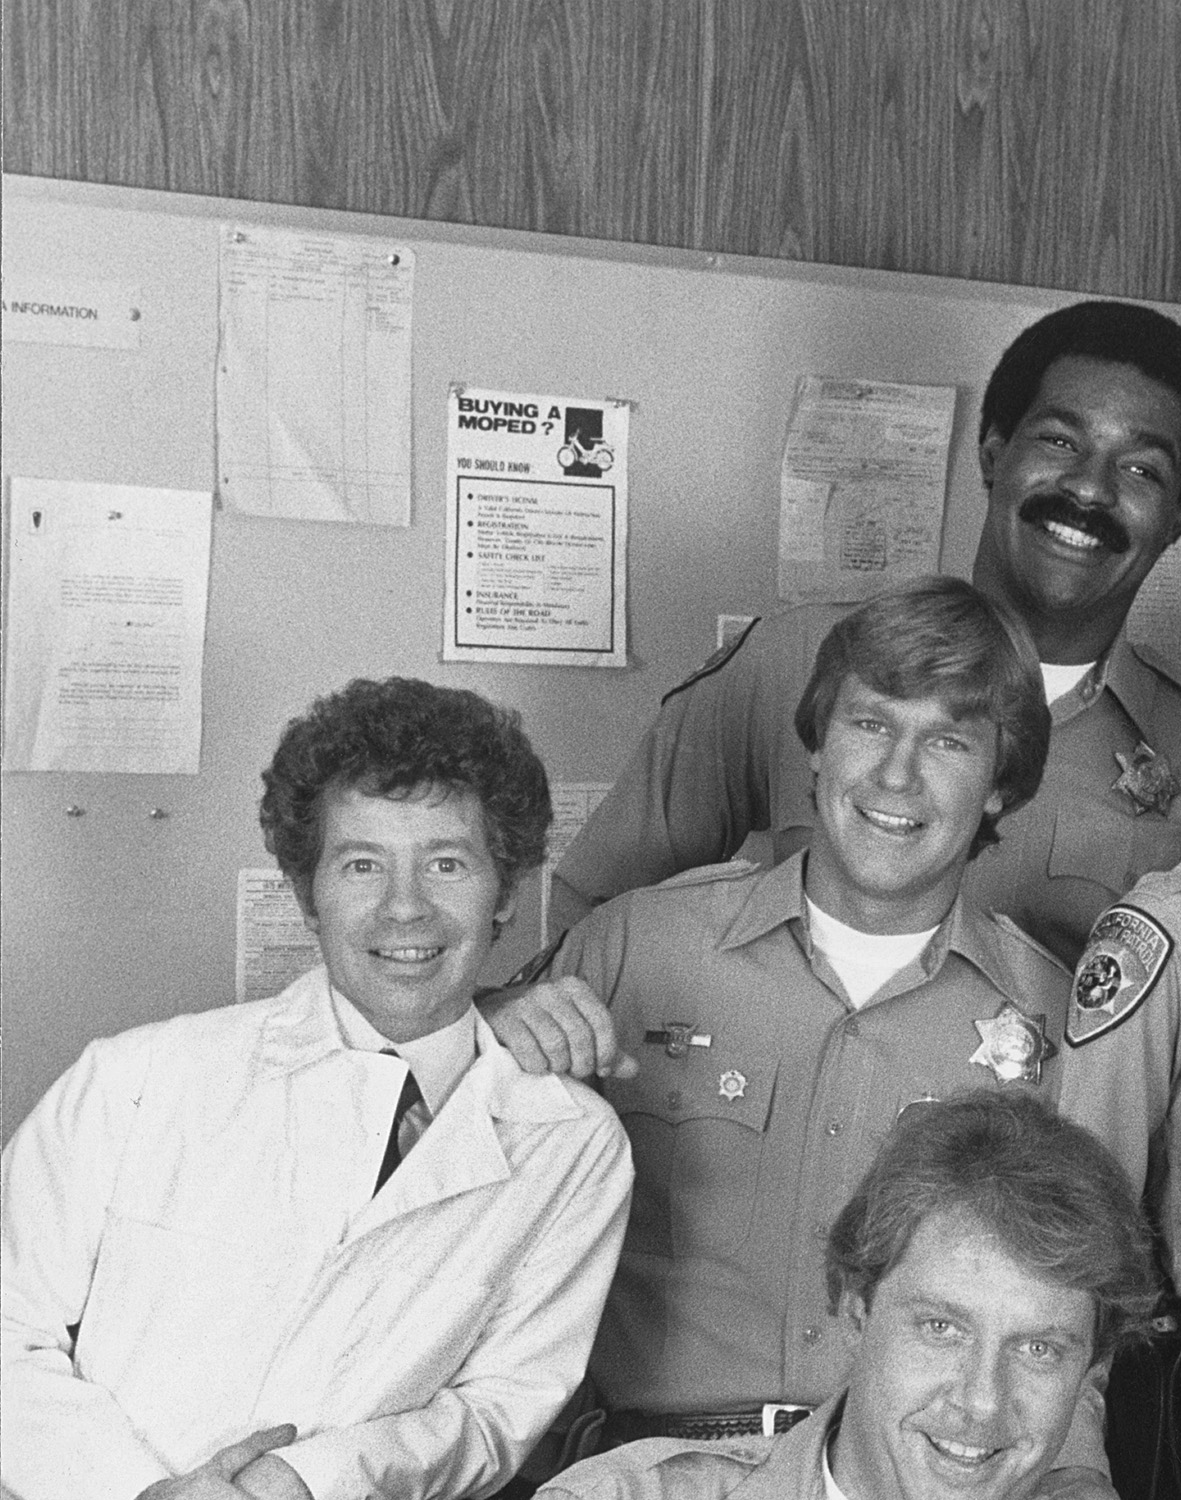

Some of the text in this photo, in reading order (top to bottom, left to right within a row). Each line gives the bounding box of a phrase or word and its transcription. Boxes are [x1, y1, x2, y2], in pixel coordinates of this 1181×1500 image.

[11, 301, 98, 320] INFORMATION
[458, 397, 562, 420] BUYING A
[458, 414, 537, 435] MOPED
[457, 457, 531, 474] YOU SHOULD KNOW
[477, 521, 529, 531] REGISTRATION
[478, 552, 546, 563] SAFETY CHECK LIST
[476, 590, 519, 600] INSURANCE
[476, 606, 497, 615] RULES
[513, 608, 525, 617] THE
[528, 608, 551, 618] ROAD
[1120, 929, 1158, 973] PATROL
